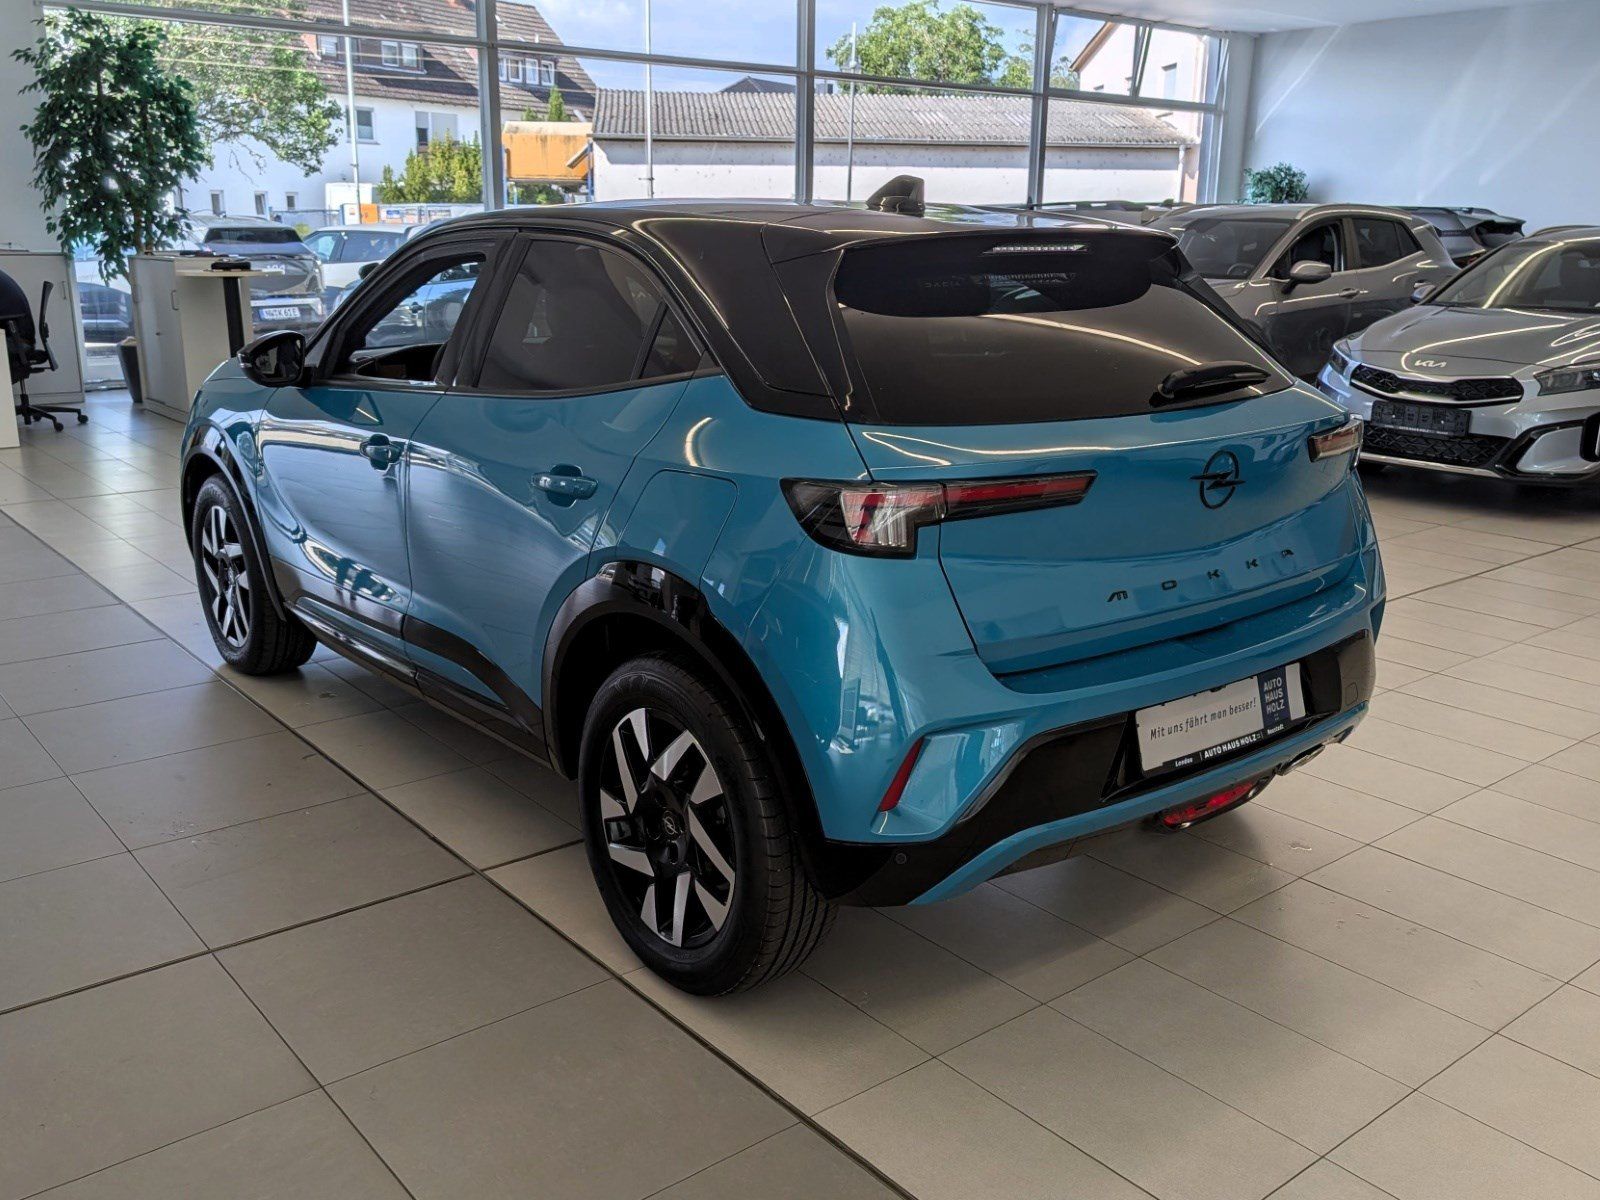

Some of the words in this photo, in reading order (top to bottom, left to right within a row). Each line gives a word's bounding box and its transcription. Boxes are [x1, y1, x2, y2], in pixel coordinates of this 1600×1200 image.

[1414, 359, 1447, 368] KIA
[1107, 549, 1295, 602] MOKKA
[1264, 677, 1282, 691] AUTO
[1265, 688, 1284, 703] HAUS
[1266, 699, 1286, 714] HOLZ
[1150, 728, 1165, 740] Mit
[1167, 722, 1183, 735] uns
[1185, 714, 1208, 732] fährt
[1210, 709, 1227, 721] man
[1229, 697, 1257, 715] besser!
[1204, 745, 1222, 759] AUTO
[1222, 740, 1240, 752] HAUS
[1240, 734, 1257, 746] HOLZ
